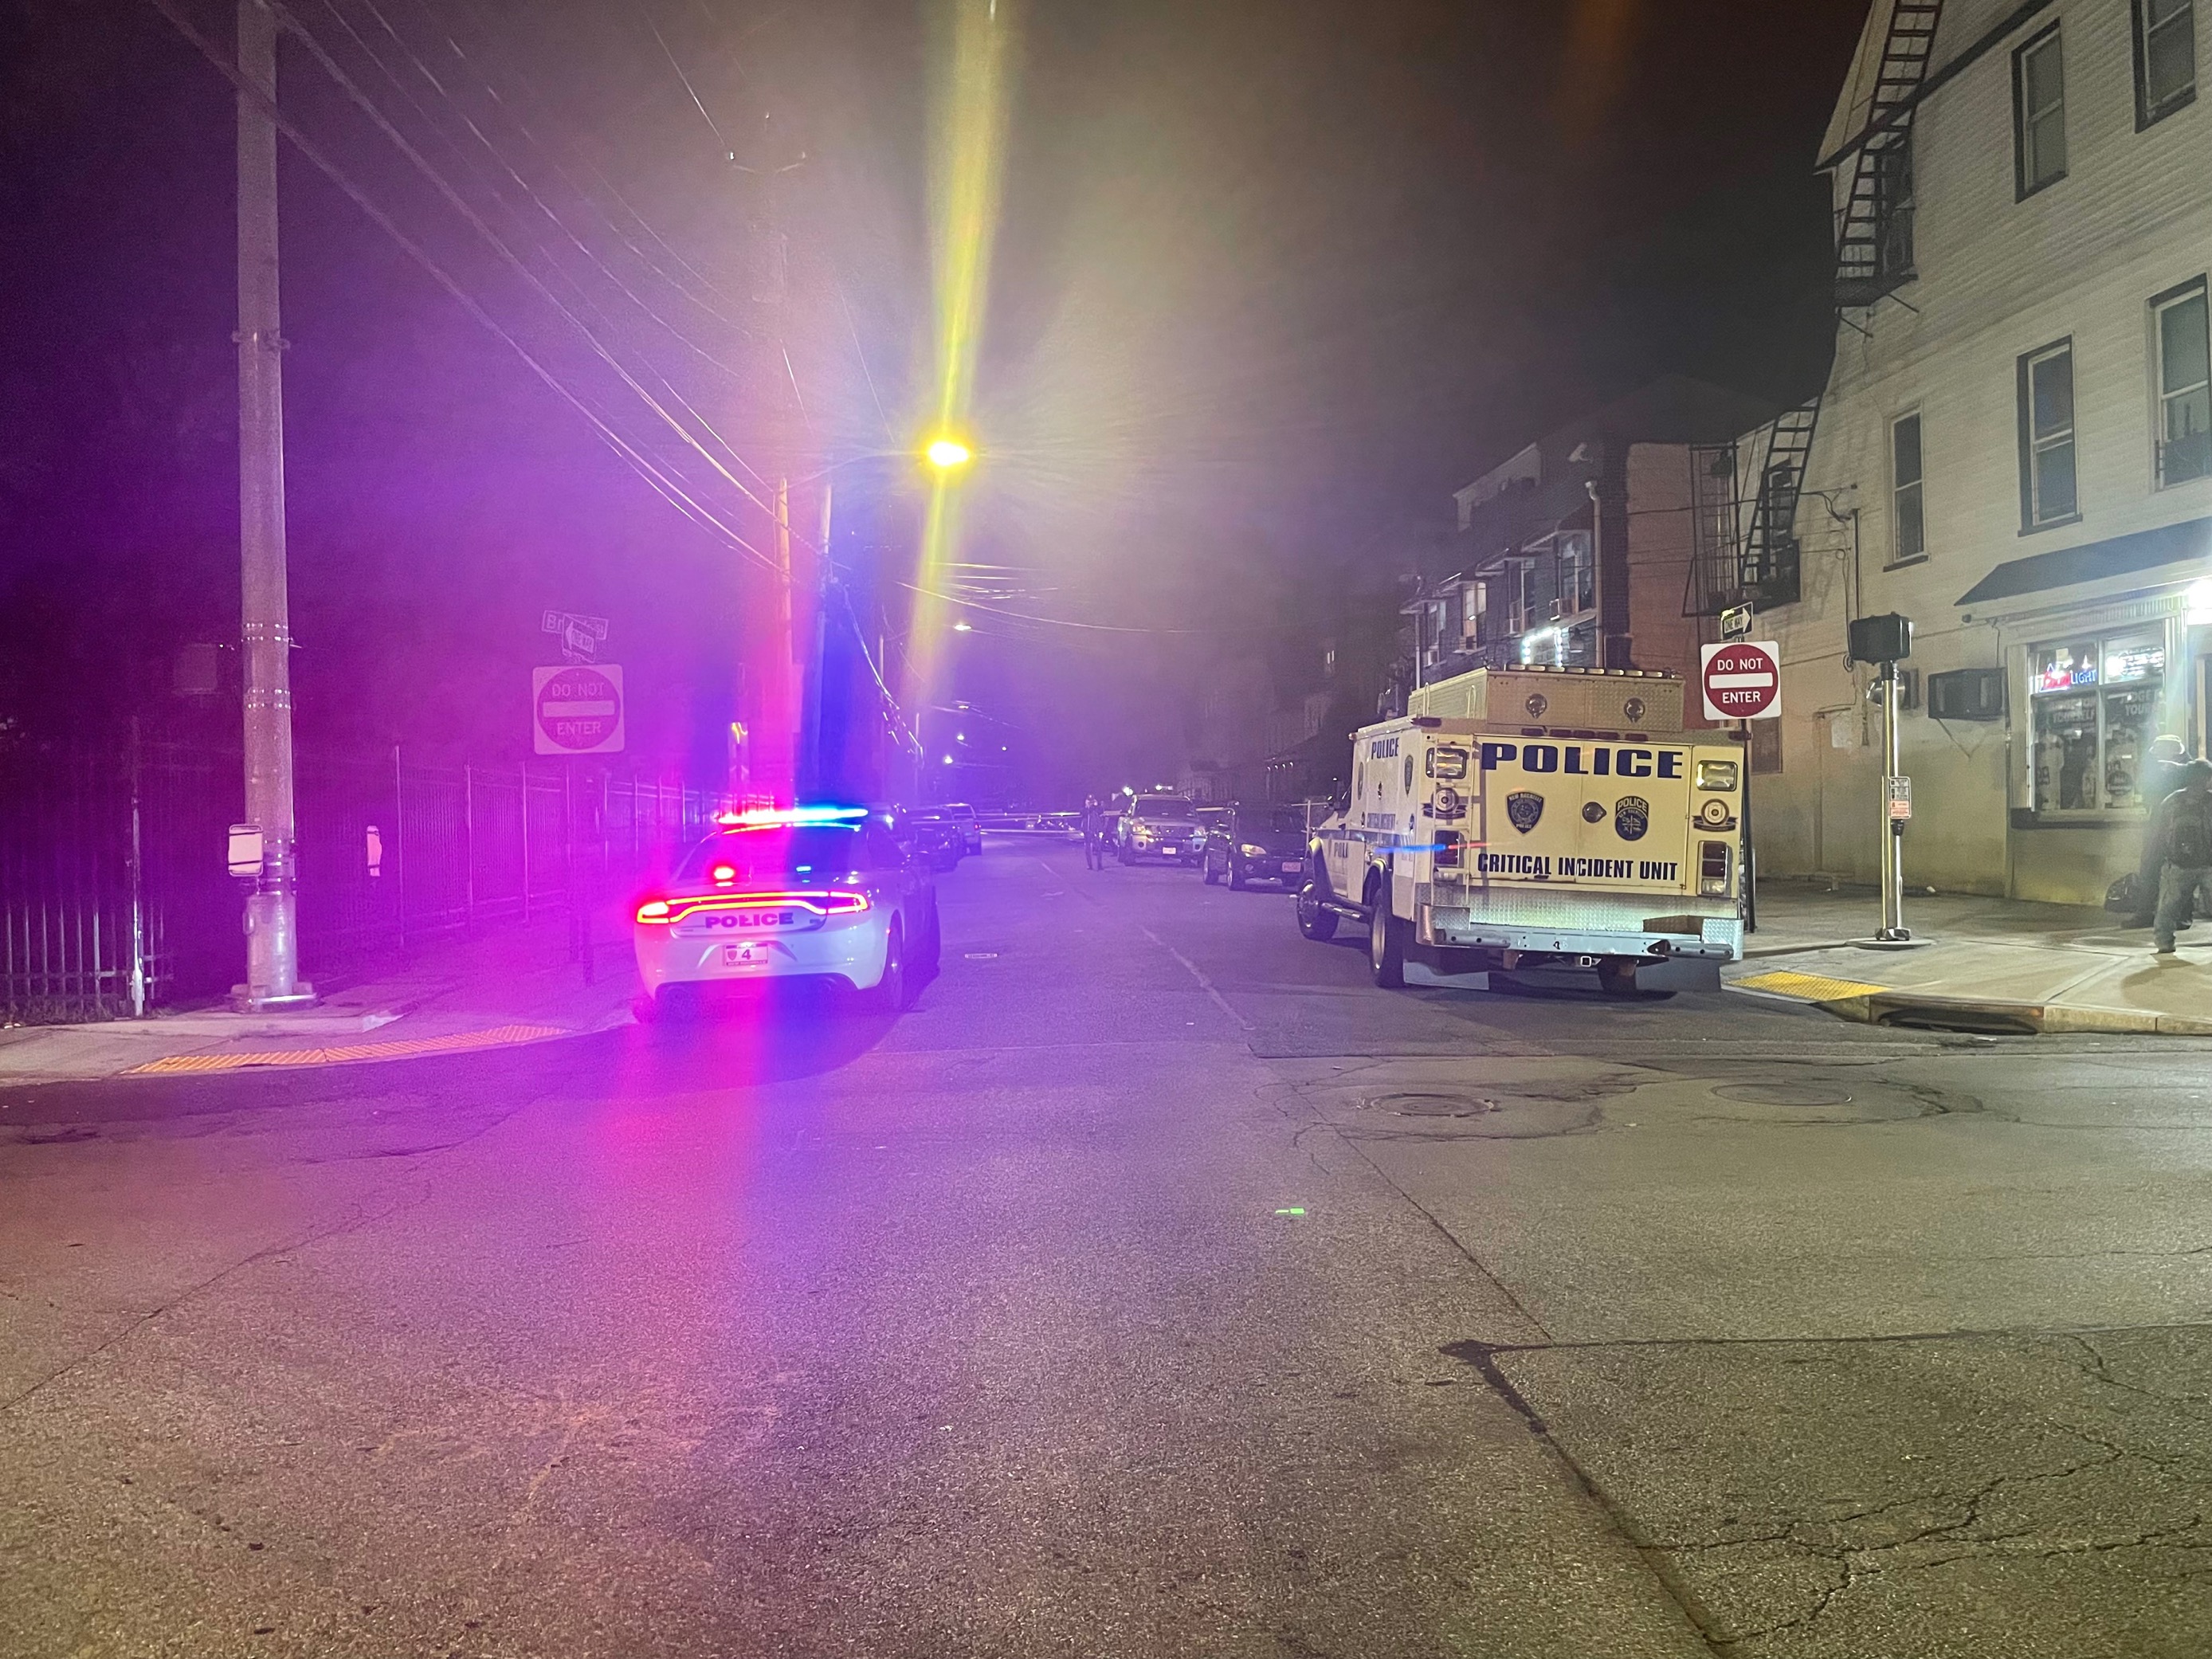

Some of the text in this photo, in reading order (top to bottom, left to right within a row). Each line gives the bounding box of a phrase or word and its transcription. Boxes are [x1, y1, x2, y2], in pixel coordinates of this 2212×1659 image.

[1717, 657, 1763, 671] DO NOT
[2069, 669, 2096, 684] LIGHT
[551, 682, 605, 696] DO NOT
[1722, 691, 1761, 704] ENTER
[557, 721, 602, 735] ENTER
[1371, 737, 1398, 759] POLICE
[1481, 742, 1683, 779] POLICE
[1617, 797, 1647, 814] POLICE
[1477, 853, 1678, 880] CRITICAL INCIDENT UNIT
[705, 912, 794, 928] POLICE
[741, 949, 751, 960] 4
